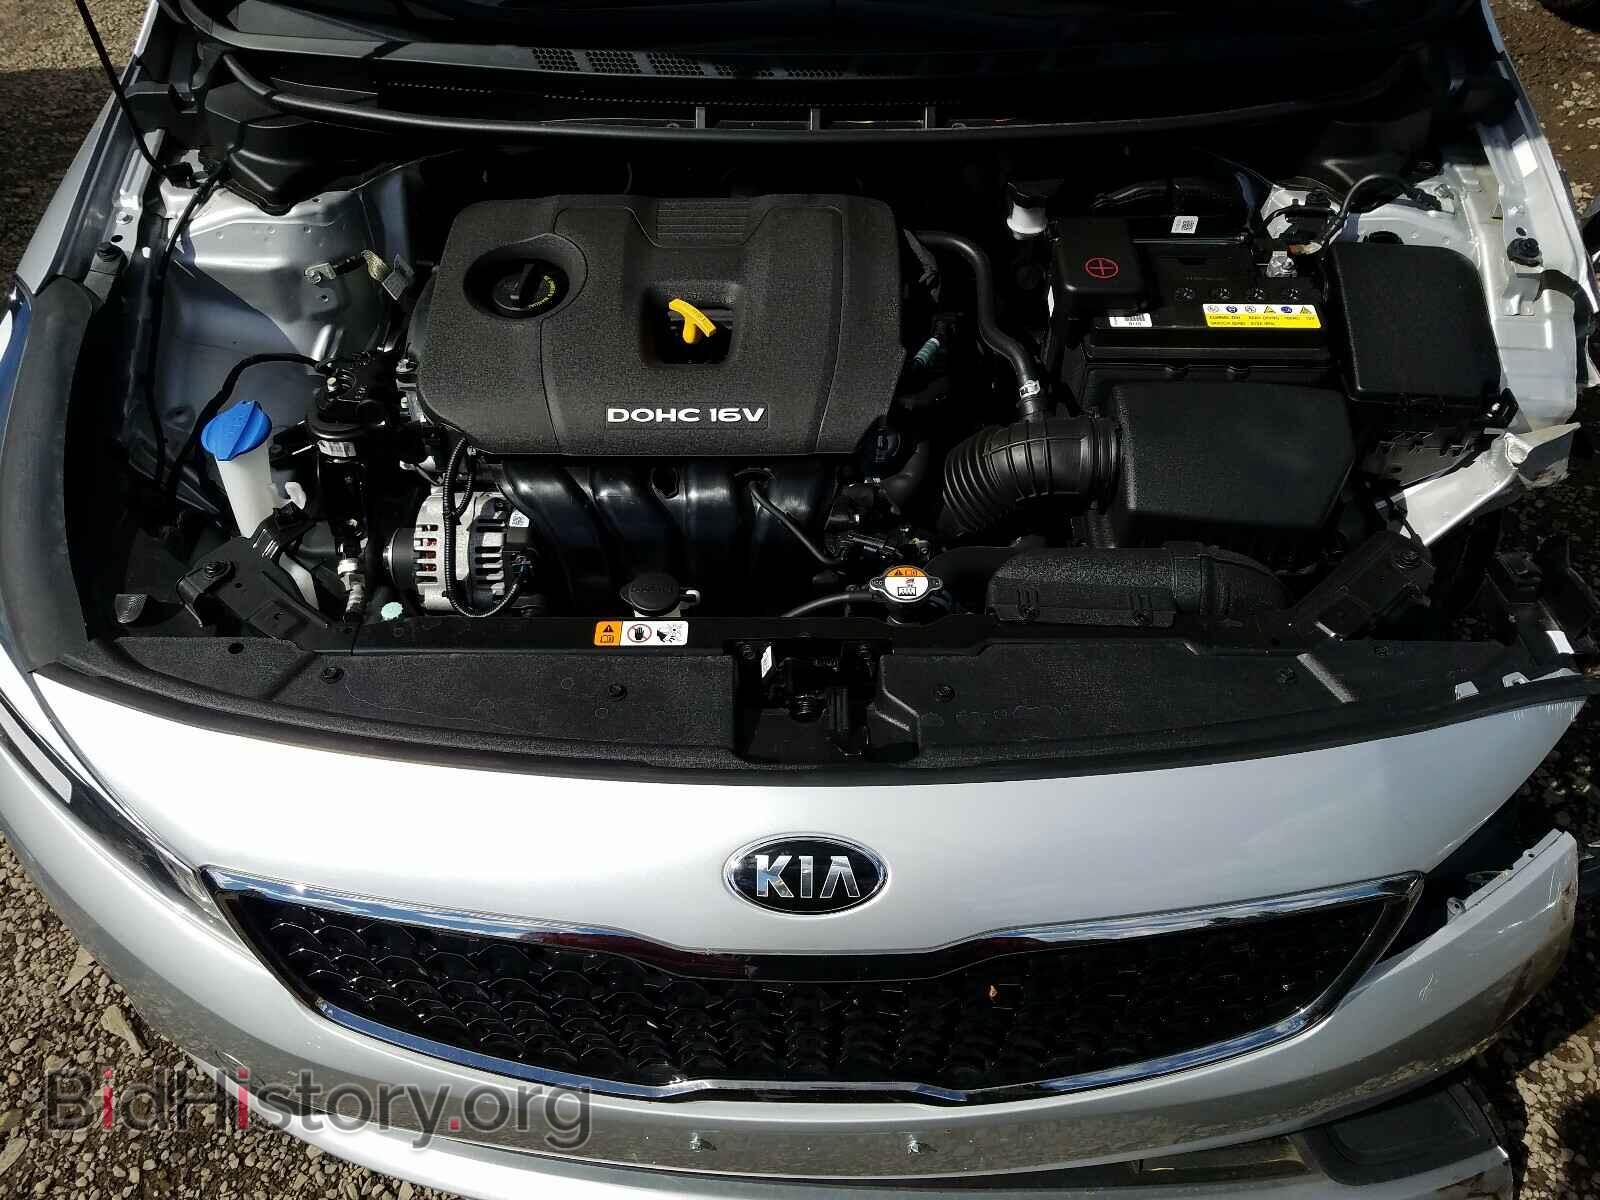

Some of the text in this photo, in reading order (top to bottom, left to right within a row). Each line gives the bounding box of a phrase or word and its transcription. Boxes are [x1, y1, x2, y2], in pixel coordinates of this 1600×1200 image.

[607, 407, 765, 422] DOHC 16V
[754, 854, 861, 899] KIA
